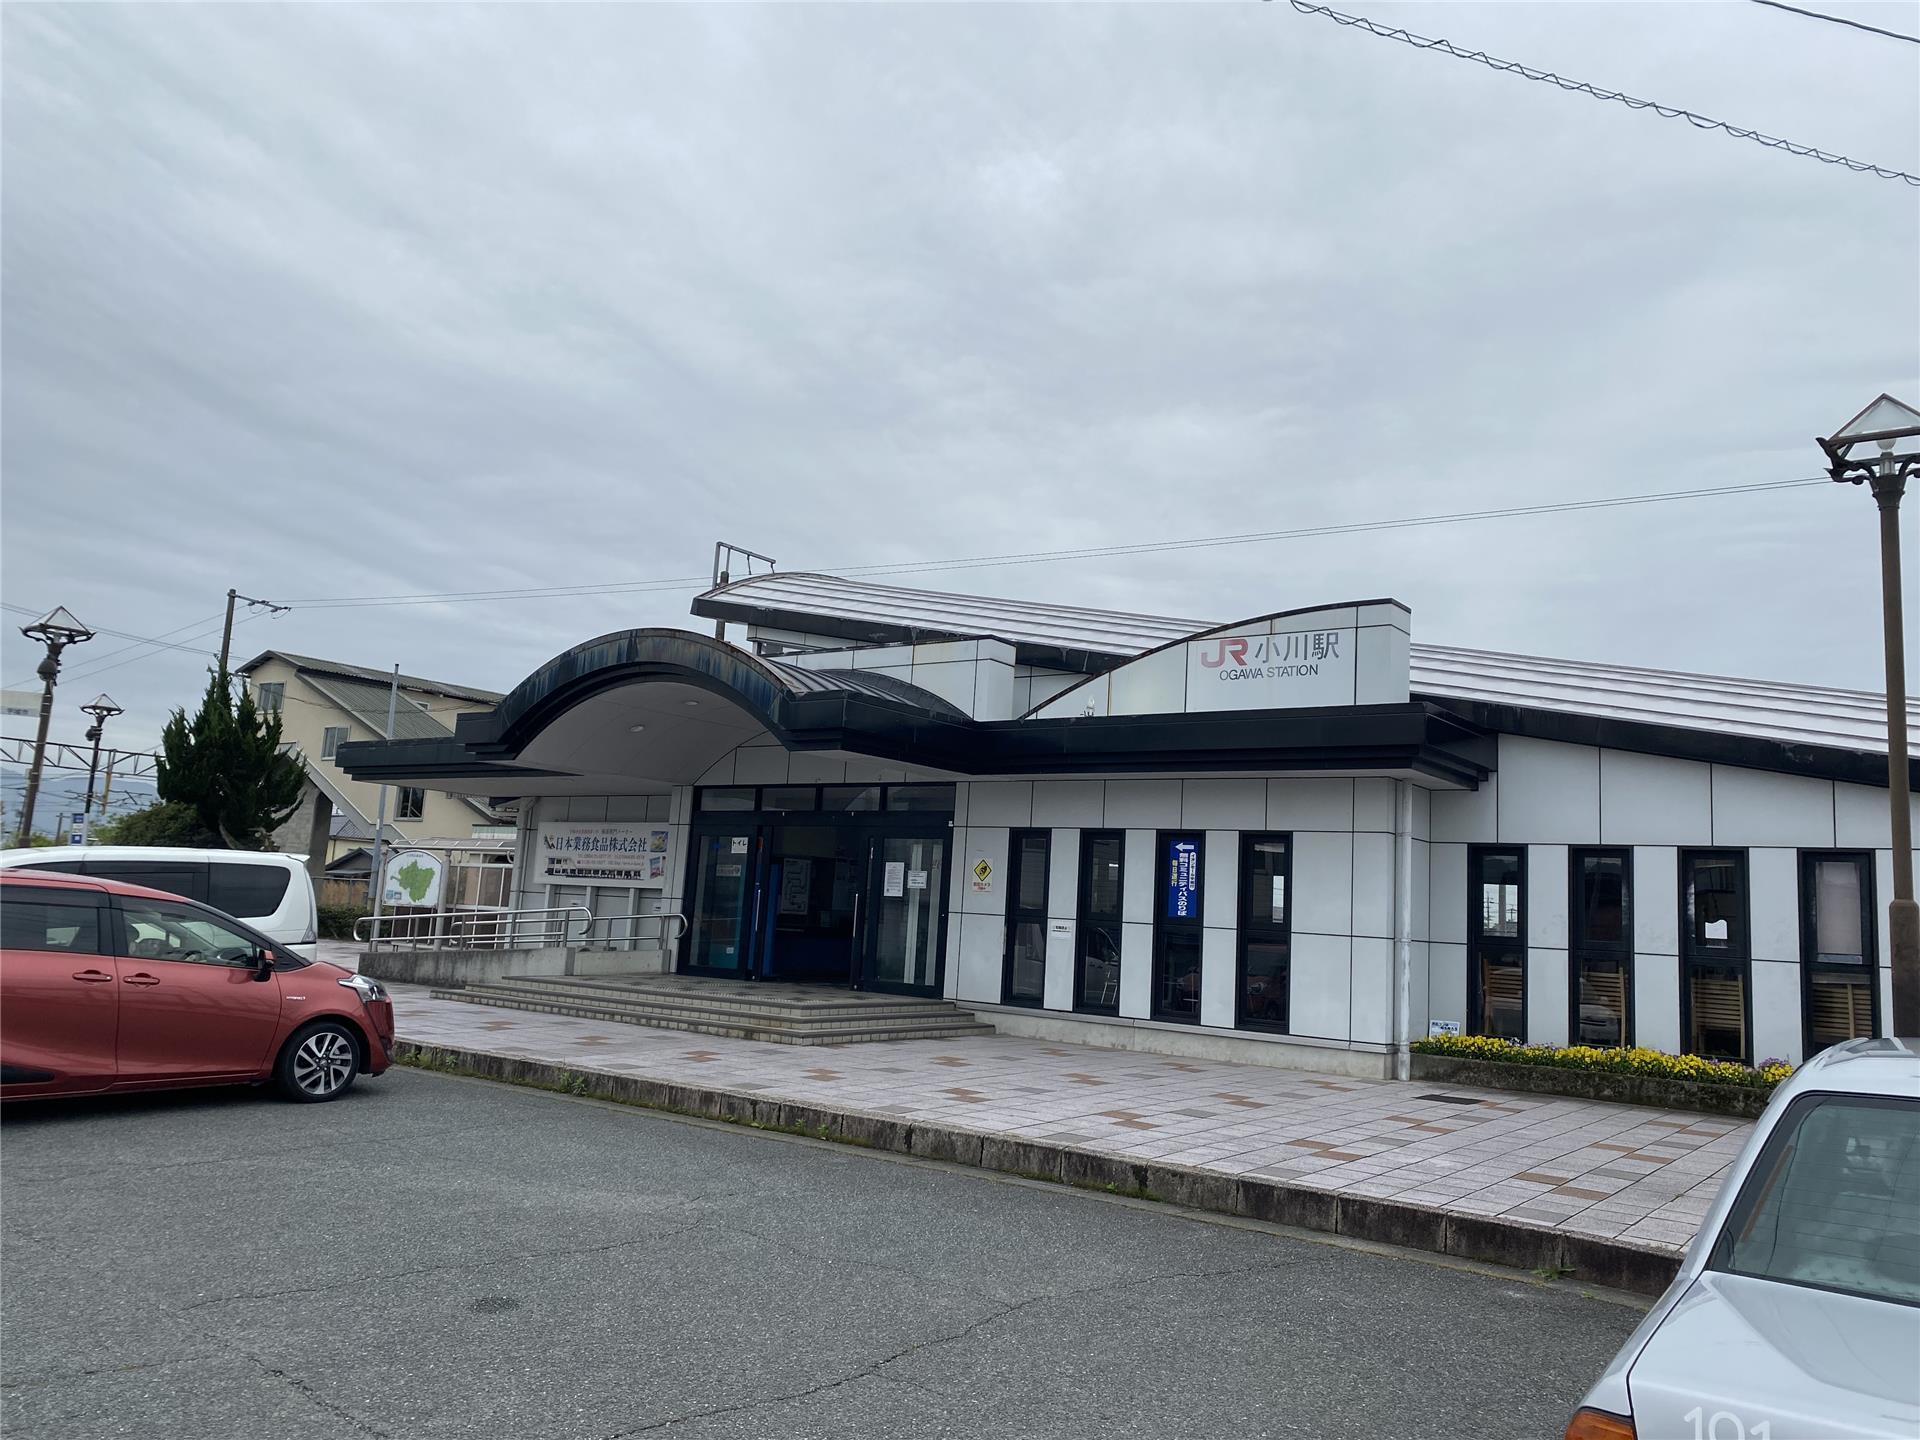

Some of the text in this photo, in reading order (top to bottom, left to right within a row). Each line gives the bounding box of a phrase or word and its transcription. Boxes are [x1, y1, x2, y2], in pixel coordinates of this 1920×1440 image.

[1201, 638, 1249, 668] JR
[1255, 632, 1339, 663] 小川駅
[1219, 664, 1319, 681] OGAWA STATION
[555, 836, 648, 853] 日本業務食品株式会社
